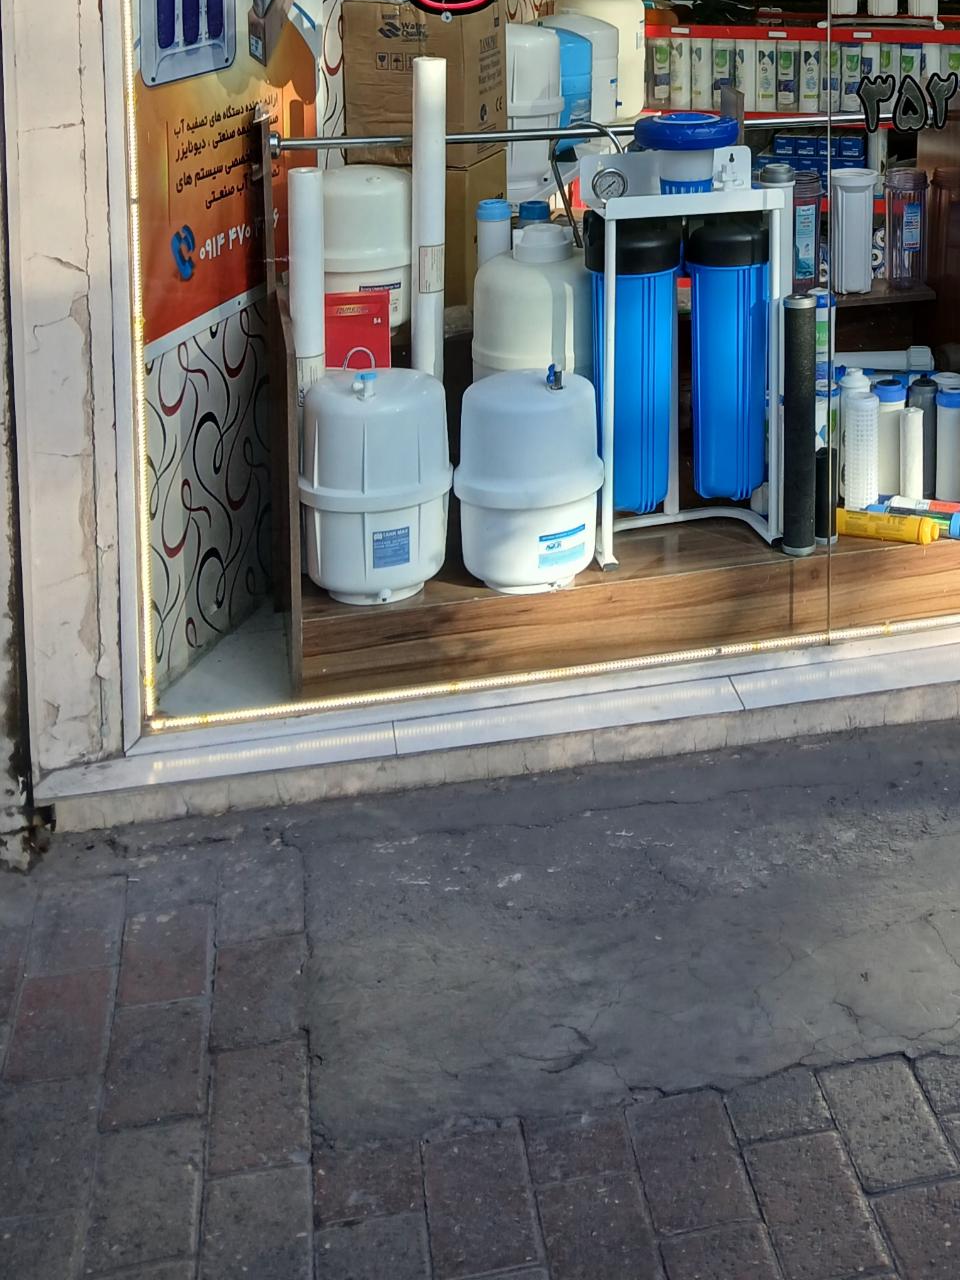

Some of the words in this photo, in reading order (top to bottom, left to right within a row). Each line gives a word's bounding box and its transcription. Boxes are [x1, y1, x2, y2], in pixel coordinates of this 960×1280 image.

[400, 22, 426, 31] Water
[401, 30, 429, 40] Quality
[174, 118, 185, 138] آب
[186, 116, 208, 133] تصفیه
[212, 129, 236, 149] صنعتی
[175, 139, 206, 162] دیونایزر
[175, 172, 193, 193] های
[194, 165, 224, 187] سیستم
[205, 184, 235, 209] صنعتی
